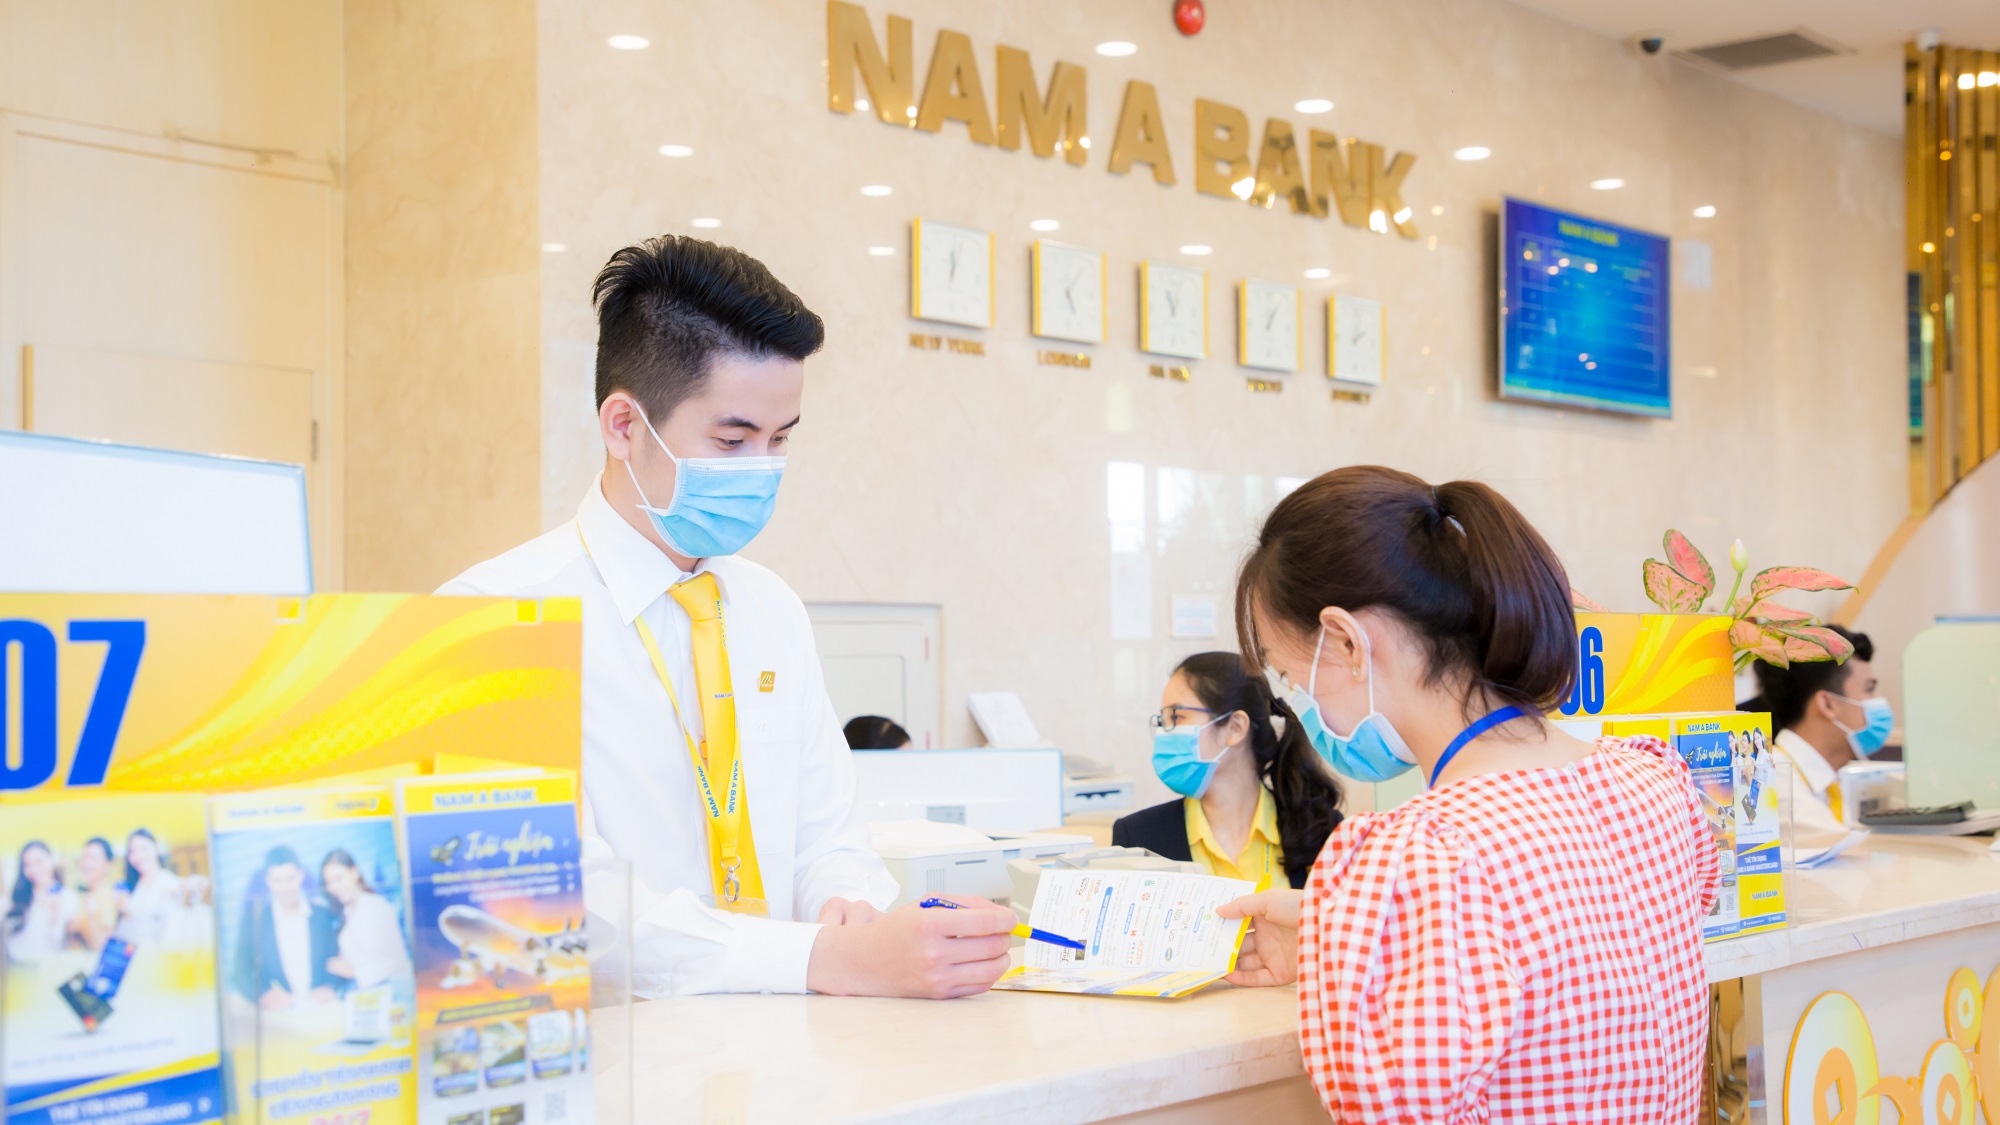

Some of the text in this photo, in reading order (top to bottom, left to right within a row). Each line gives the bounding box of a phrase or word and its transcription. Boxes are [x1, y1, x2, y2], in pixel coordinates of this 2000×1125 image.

[828, 0, 1418, 238] NAM A BANK
[0, 619, 146, 791] 07
[707, 797, 720, 818] NAM
[728, 790, 736, 814] BANK
